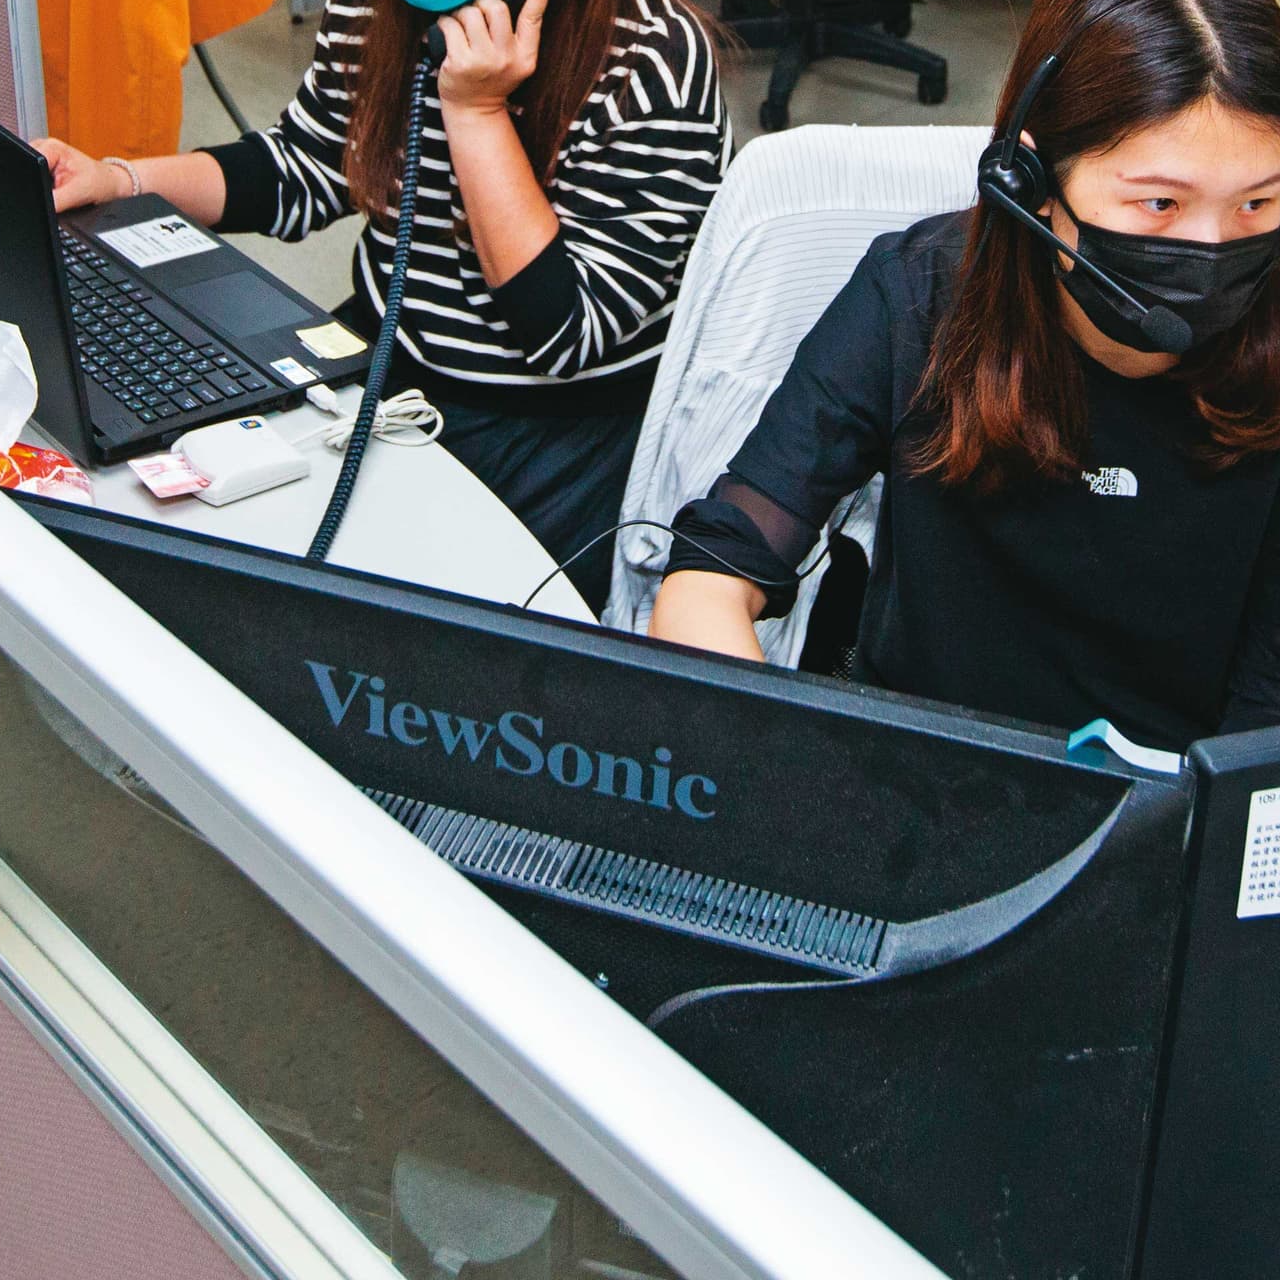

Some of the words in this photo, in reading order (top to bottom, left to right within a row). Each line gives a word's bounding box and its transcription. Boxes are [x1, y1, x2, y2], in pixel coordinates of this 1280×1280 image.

[1081, 470, 1119, 487] NORTH
[1098, 467, 1120, 478] THE
[1090, 483, 1118, 496] FACE
[304, 659, 718, 819] ViewSonic
